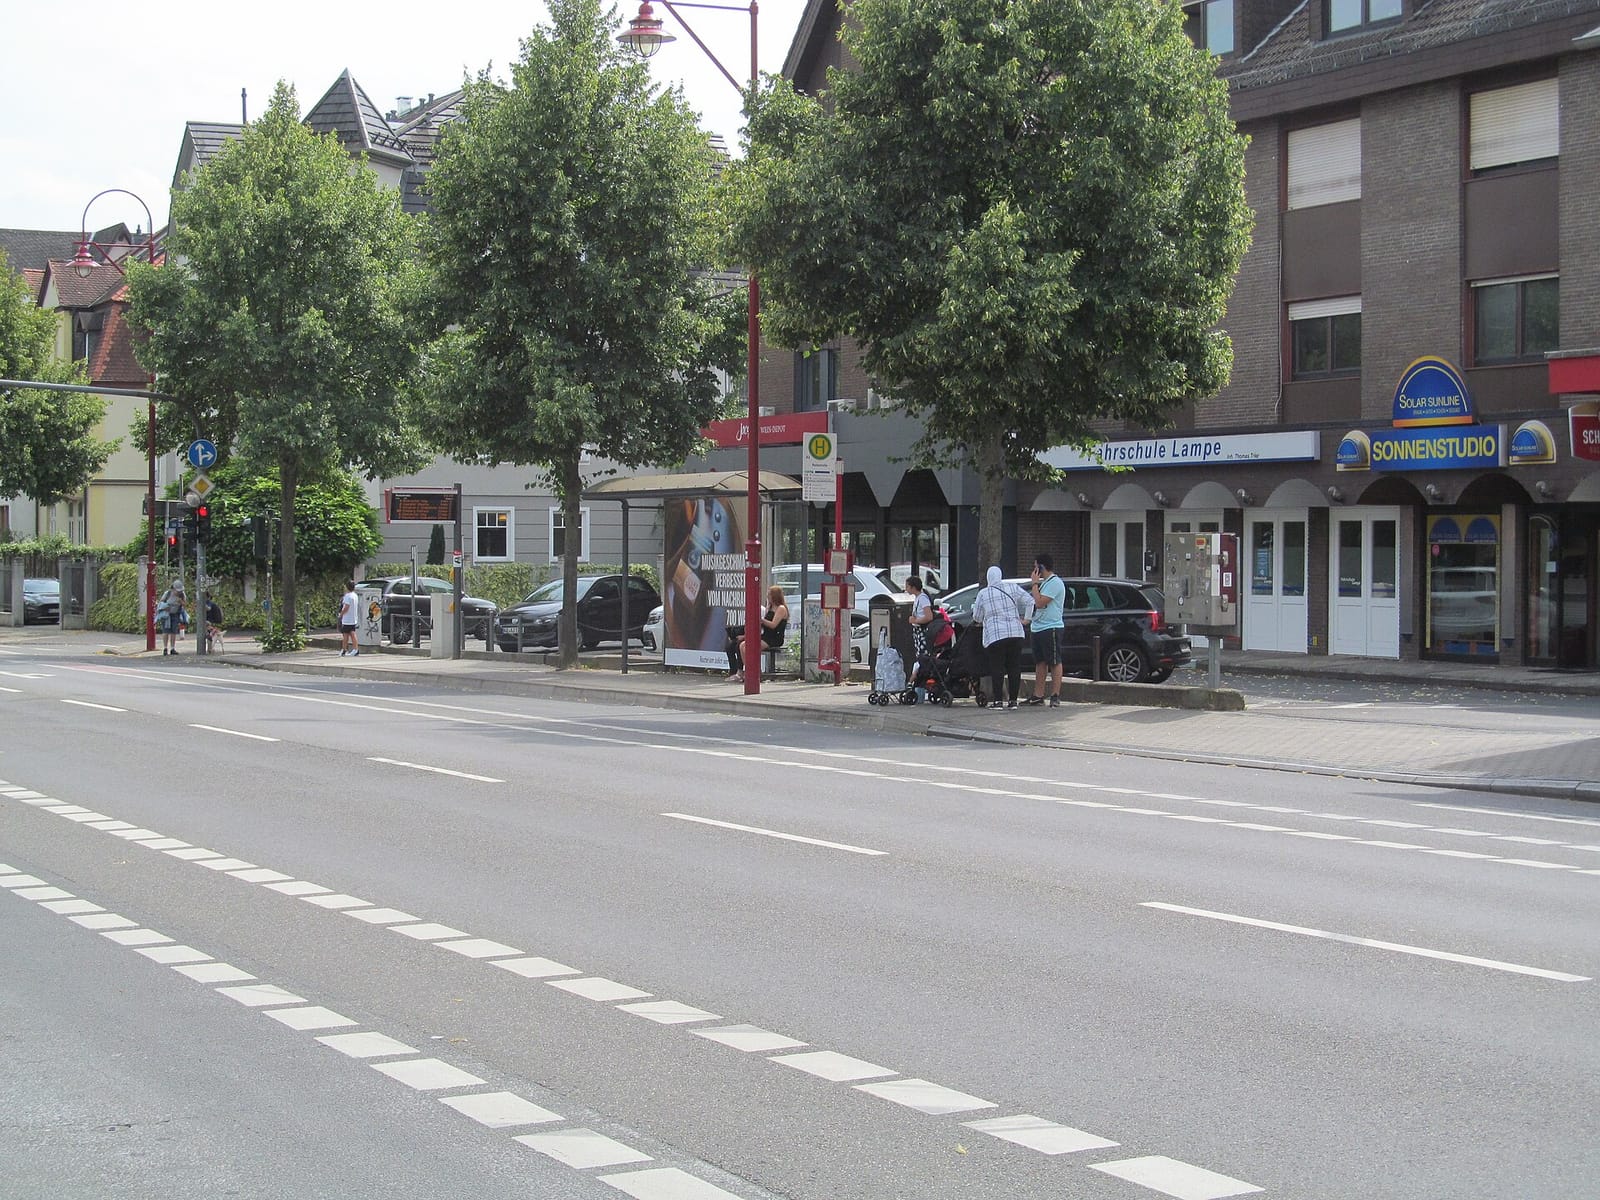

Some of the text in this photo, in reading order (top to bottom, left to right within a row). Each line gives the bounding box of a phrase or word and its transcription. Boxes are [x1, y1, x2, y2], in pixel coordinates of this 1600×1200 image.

[1399, 394, 1460, 409] SOLAR SUNLINE
[1582, 430, 1600, 445] SCH
[815, 439, 825, 455] H
[1088, 440, 1221, 462] ahrschule Lampe
[1372, 435, 1496, 461] SONNENSTUDIO
[701, 554, 746, 571] MUSIKGESCHMA
[715, 573, 746, 588] VERBESSE
[707, 590, 746, 607] VOM NACHBA
[726, 610, 737, 626] 700
